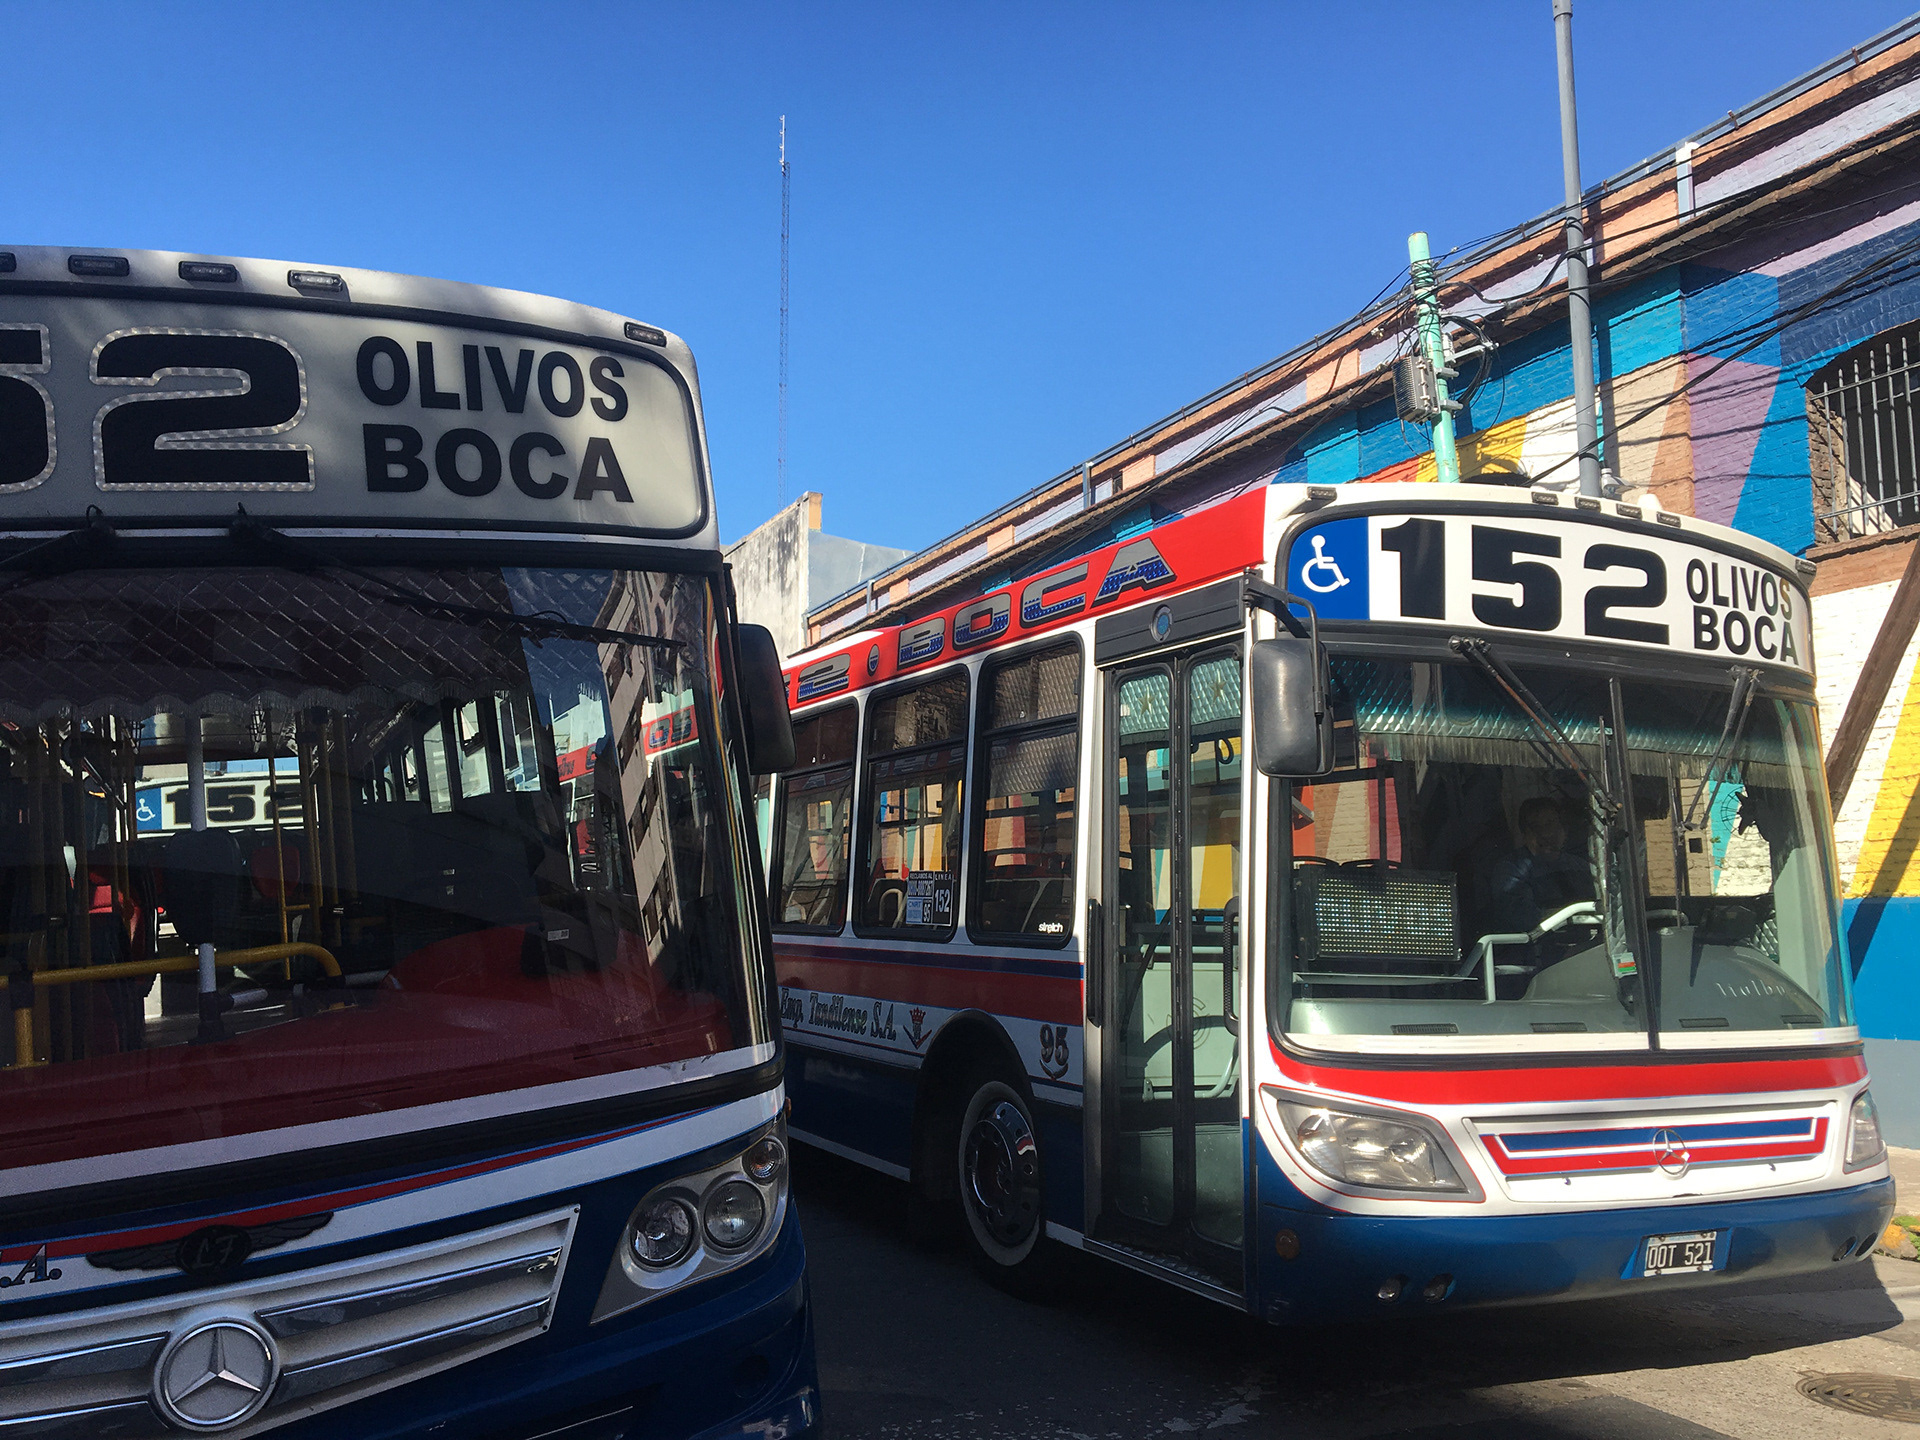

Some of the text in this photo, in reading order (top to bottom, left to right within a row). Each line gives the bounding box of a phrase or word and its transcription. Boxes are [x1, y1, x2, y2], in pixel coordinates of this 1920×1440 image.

[0, 321, 315, 492] 2
[356, 336, 628, 422] OLIVOS
[362, 422, 634, 502] BOCA
[898, 538, 1176, 668] BOCA
[1381, 517, 1669, 645] 152
[1686, 557, 1795, 621] OLIVOS
[1692, 604, 1799, 666] BOCA
[923, 903, 931, 922] 95
[935, 888, 950, 913] 152
[870, 1001, 897, 1041] S.A.
[1040, 1024, 1069, 1066] 95
[1684, 1241, 1712, 1266] 521
